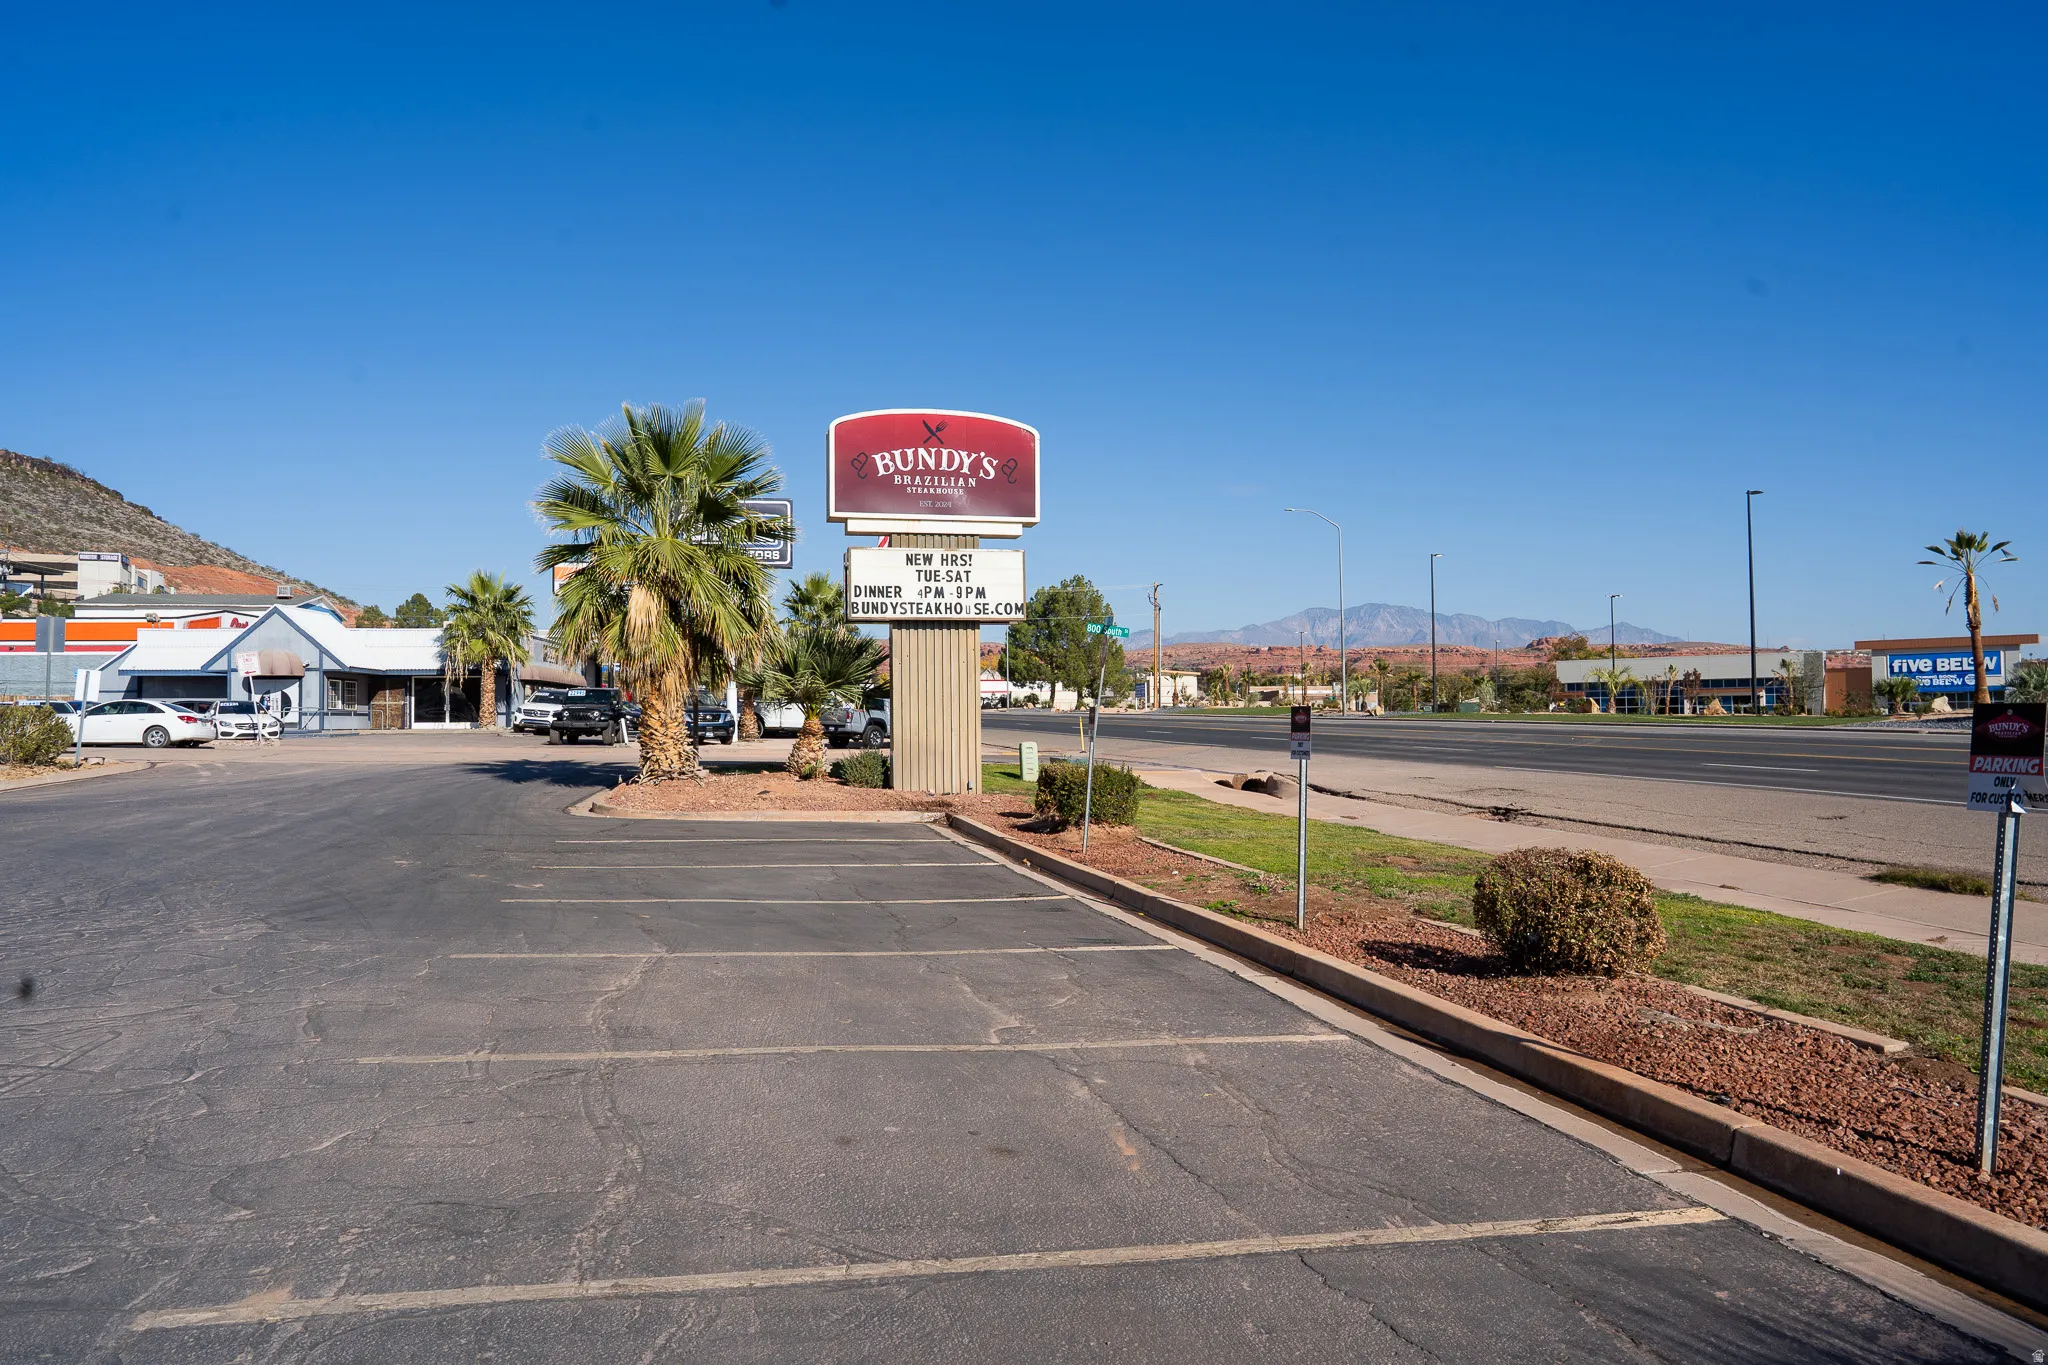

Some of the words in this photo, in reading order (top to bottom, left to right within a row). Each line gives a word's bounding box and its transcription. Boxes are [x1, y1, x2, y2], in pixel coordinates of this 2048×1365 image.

[871, 447, 999, 480] BUNDY'S
[893, 474, 977, 488] BRAZILIAN
[906, 486, 965, 495] STEAKHOUSE
[934, 500, 952, 509] 2024
[905, 553, 934, 566] NEW
[941, 553, 973, 567] HRS!
[915, 569, 972, 583] TUE-SAT
[853, 585, 903, 598] DINNER
[917, 586, 945, 599] 4PM
[1087, 623, 1101, 633] 800
[1104, 625, 1122, 636] South
[1892, 658, 1933, 673] five
[1988, 722, 2030, 734] BUNDY'S
[1973, 756, 2040, 774] PARKING
[1993, 775, 2017, 788] ONLY
[1970, 791, 1988, 803] FOR
